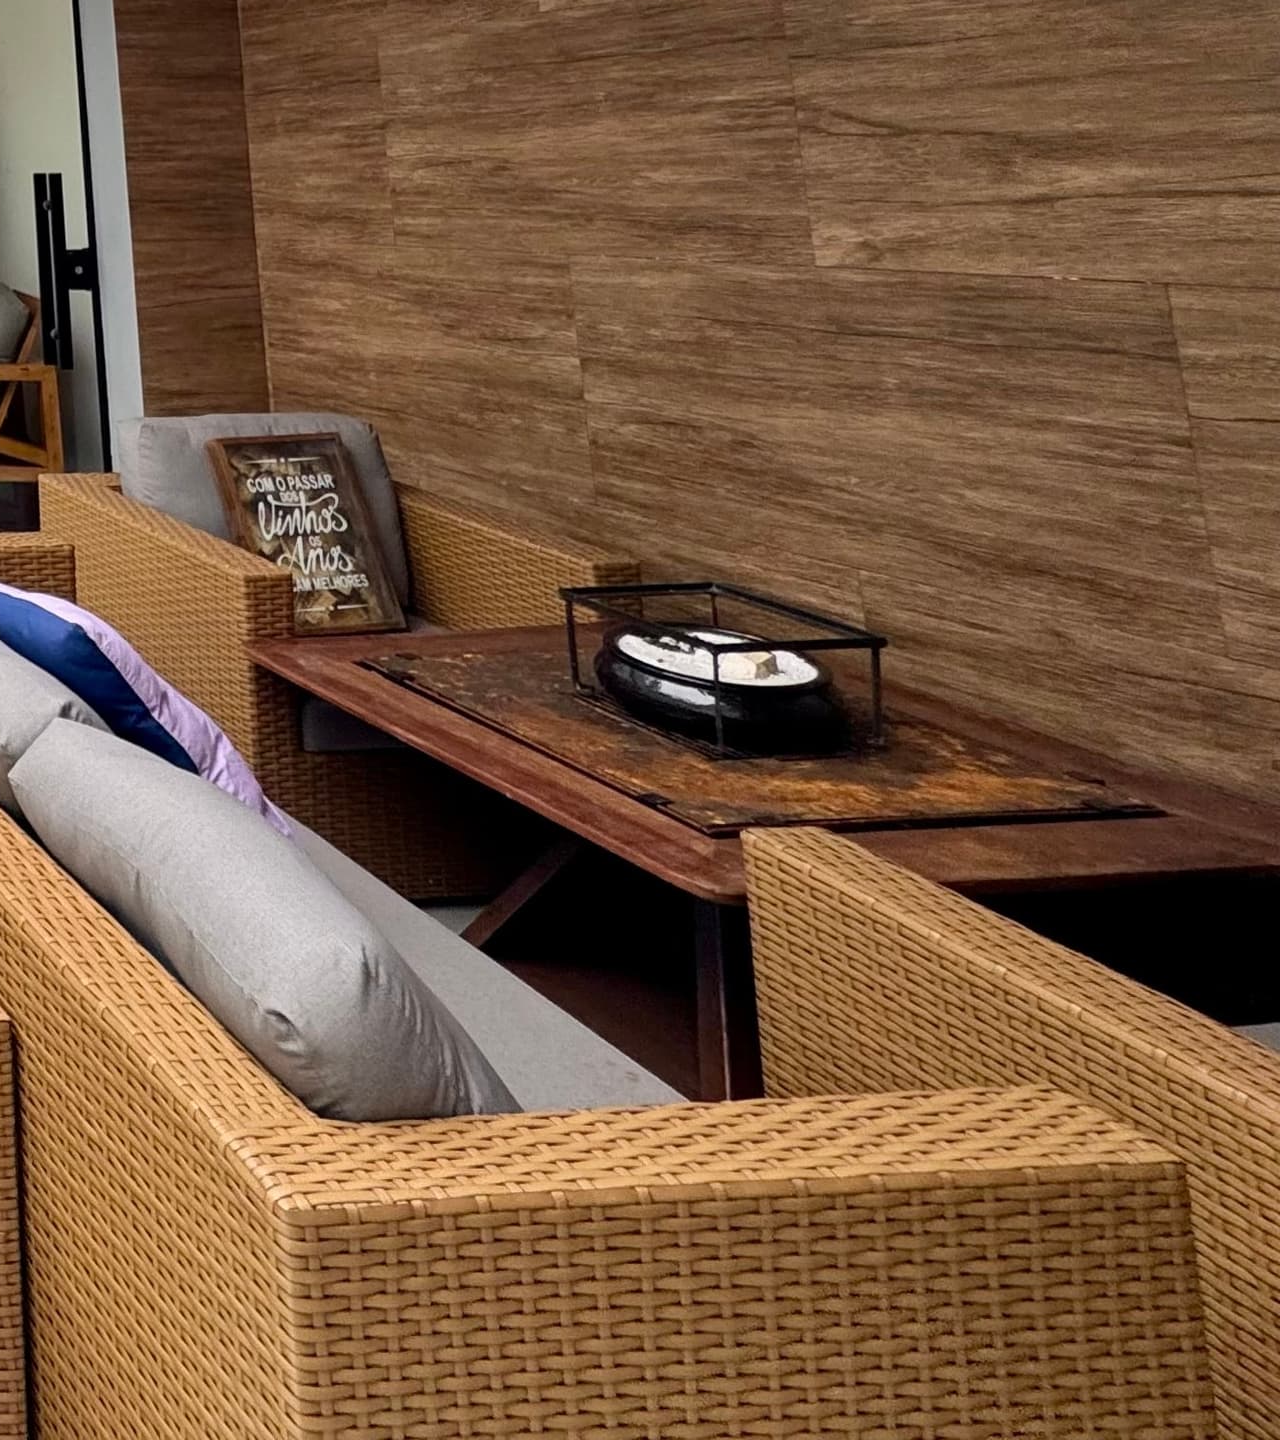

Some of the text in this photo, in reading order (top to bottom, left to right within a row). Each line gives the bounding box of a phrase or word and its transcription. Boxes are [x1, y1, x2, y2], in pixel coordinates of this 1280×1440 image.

[246, 473, 335, 494] COM O PASSAR
[257, 491, 348, 541] Vinhos
[308, 535, 323, 547] OS
[277, 535, 354, 575] Anos
[311, 573, 369, 591] MELHORES
